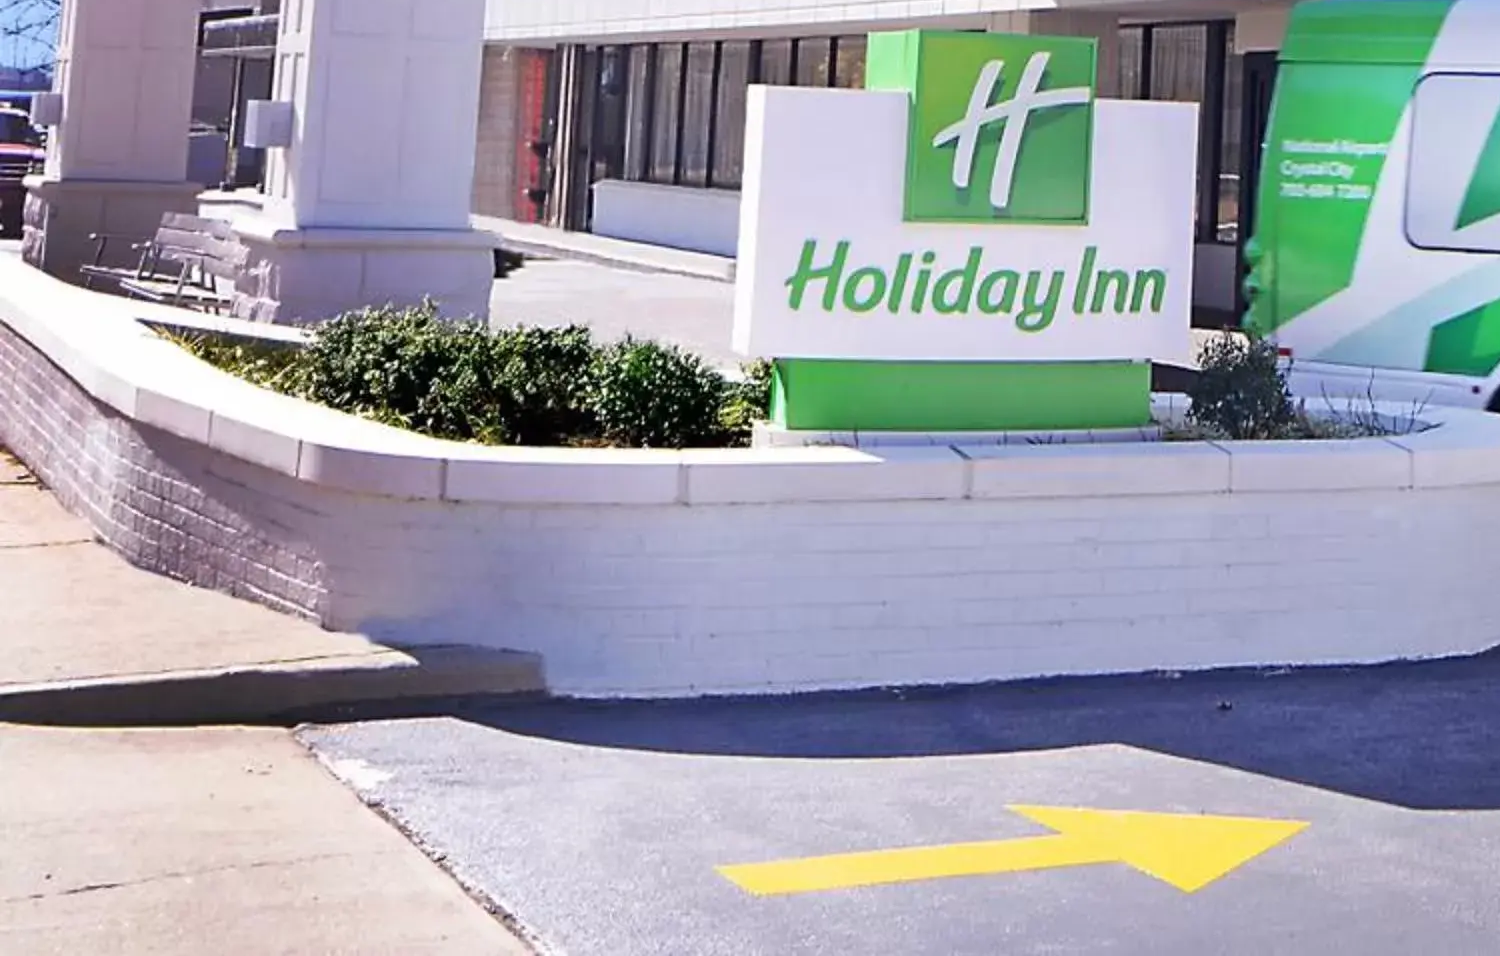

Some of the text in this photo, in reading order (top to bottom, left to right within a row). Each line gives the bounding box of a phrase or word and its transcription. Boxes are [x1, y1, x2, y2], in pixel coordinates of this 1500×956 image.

[932, 51, 1091, 208] H
[1329, 161, 1357, 180] City
[785, 239, 1167, 332] Holiday Inn
